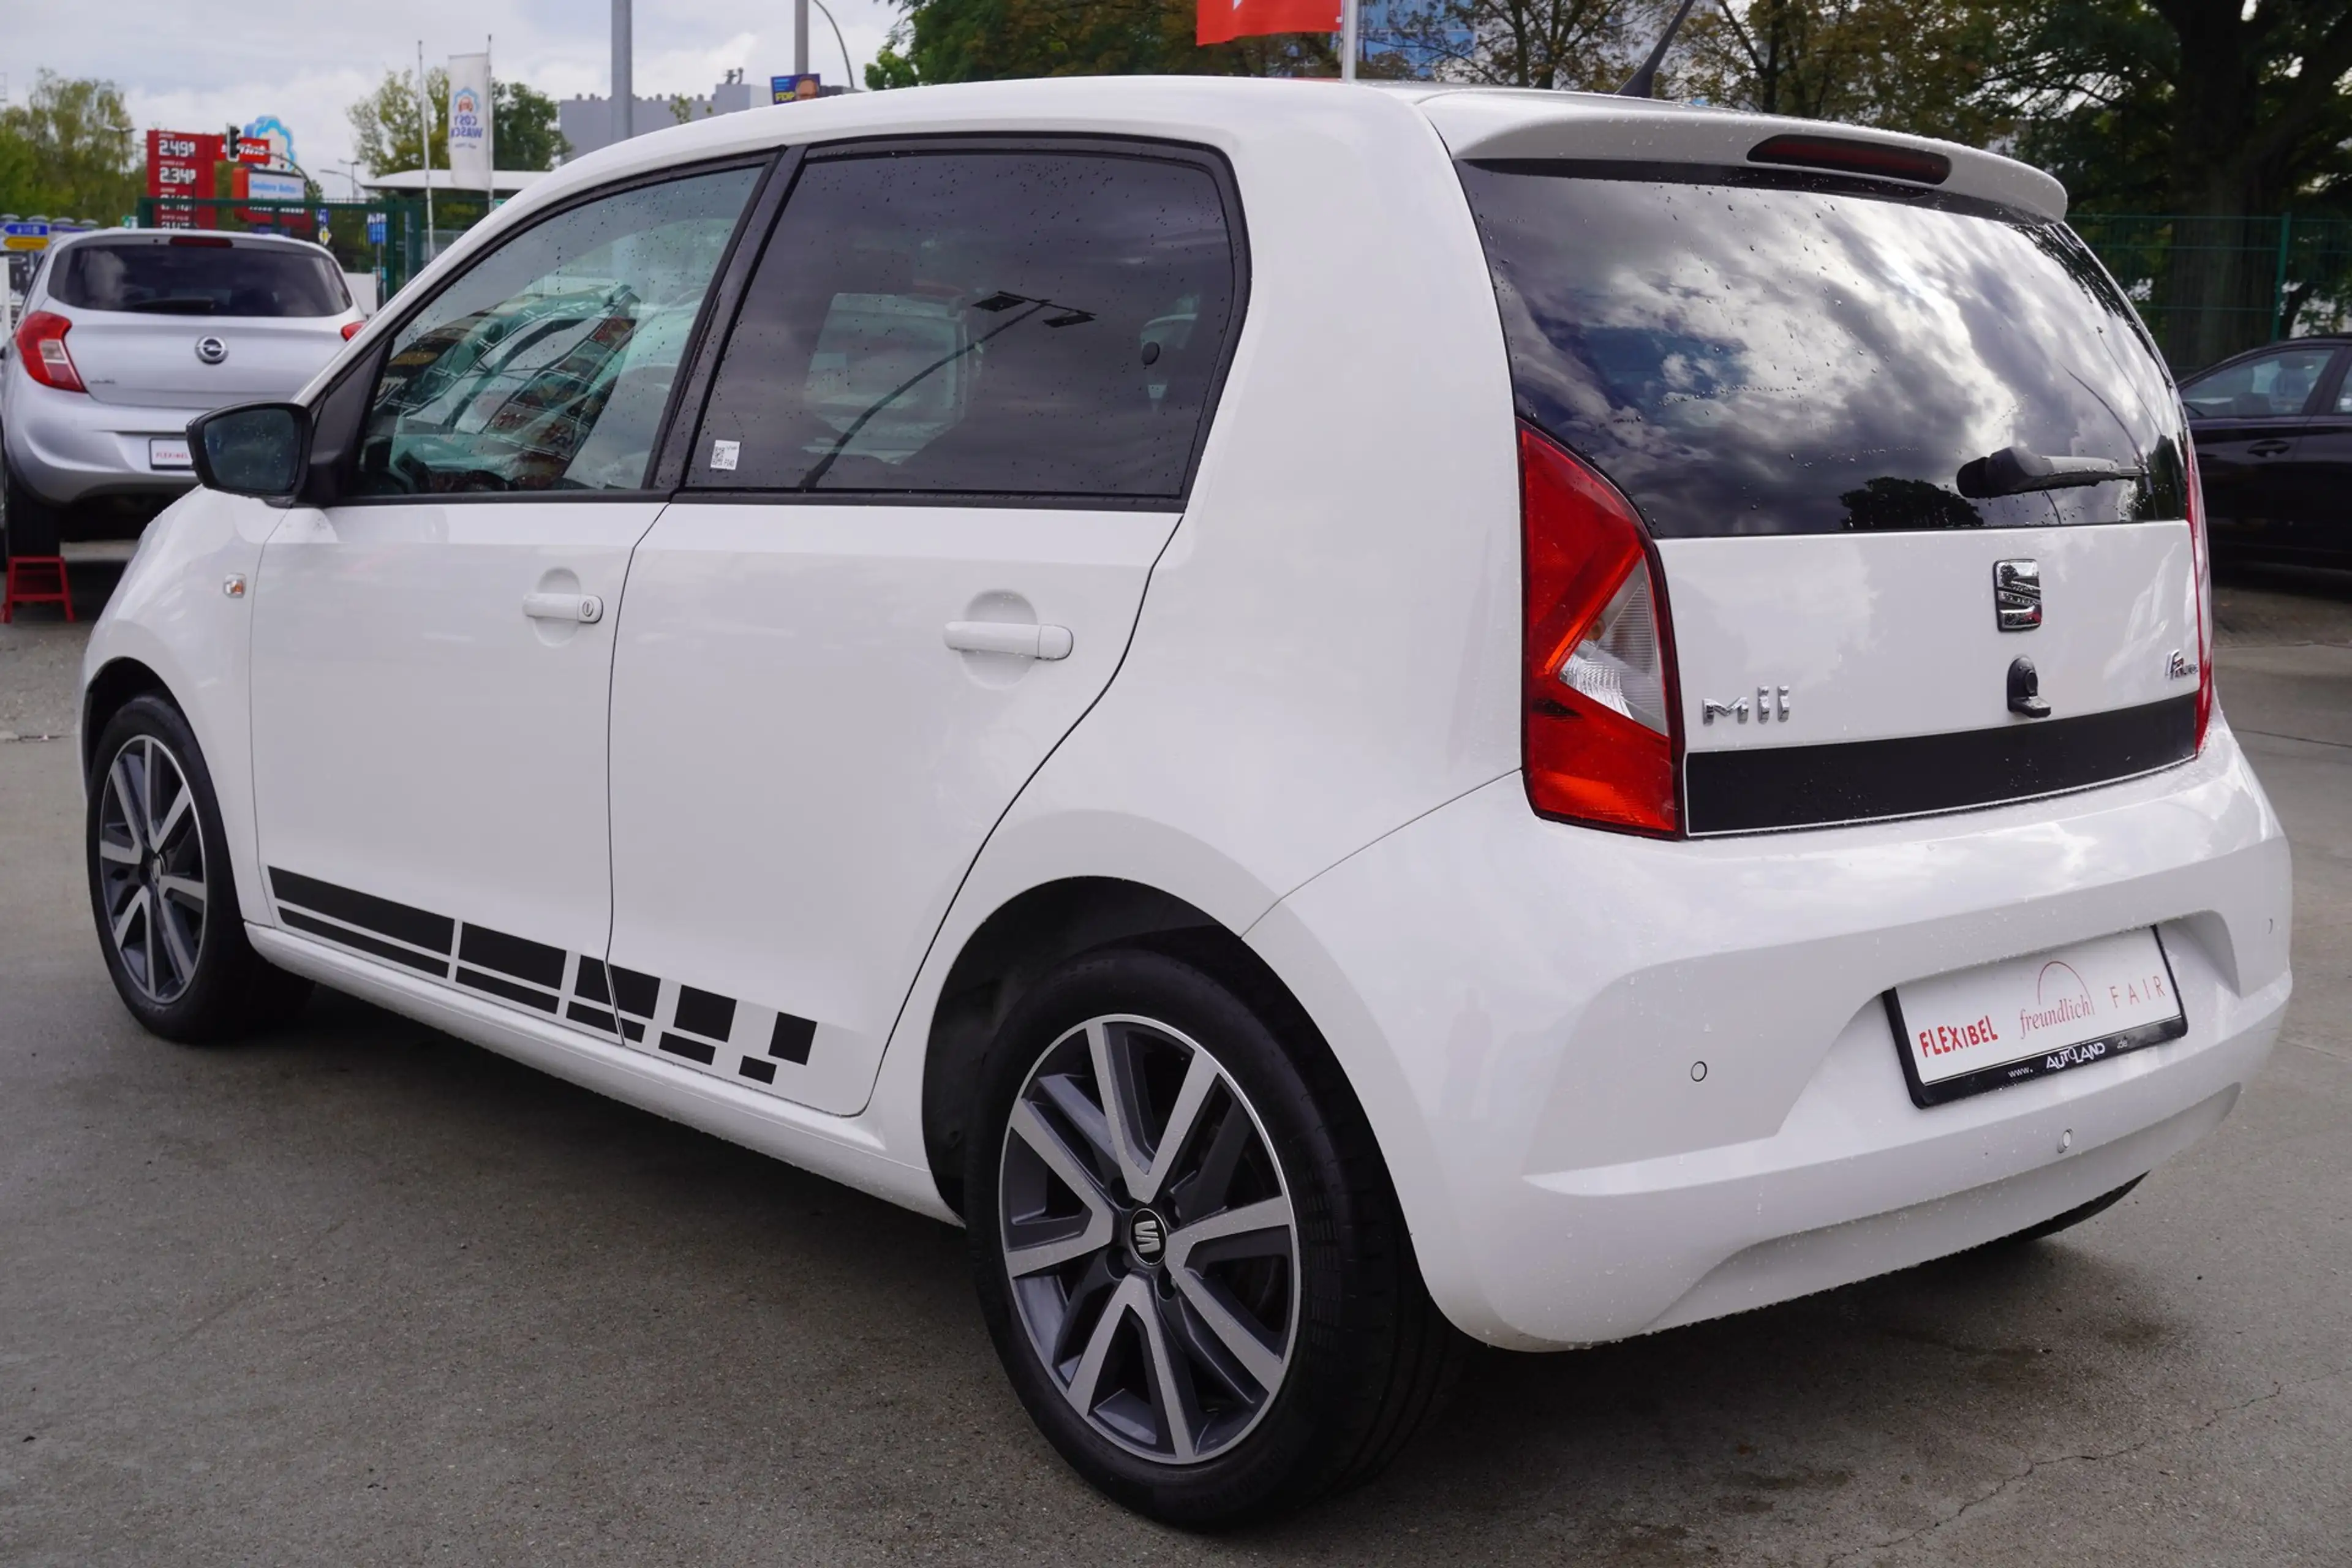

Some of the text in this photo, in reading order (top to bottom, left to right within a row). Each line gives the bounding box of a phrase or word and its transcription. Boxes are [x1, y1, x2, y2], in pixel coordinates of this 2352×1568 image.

[1919, 1014, 1999, 1058] FLEXIBEL
[2019, 995, 2091, 1040] freundlich
[2046, 1042, 2106, 1069] AUTOLAND
